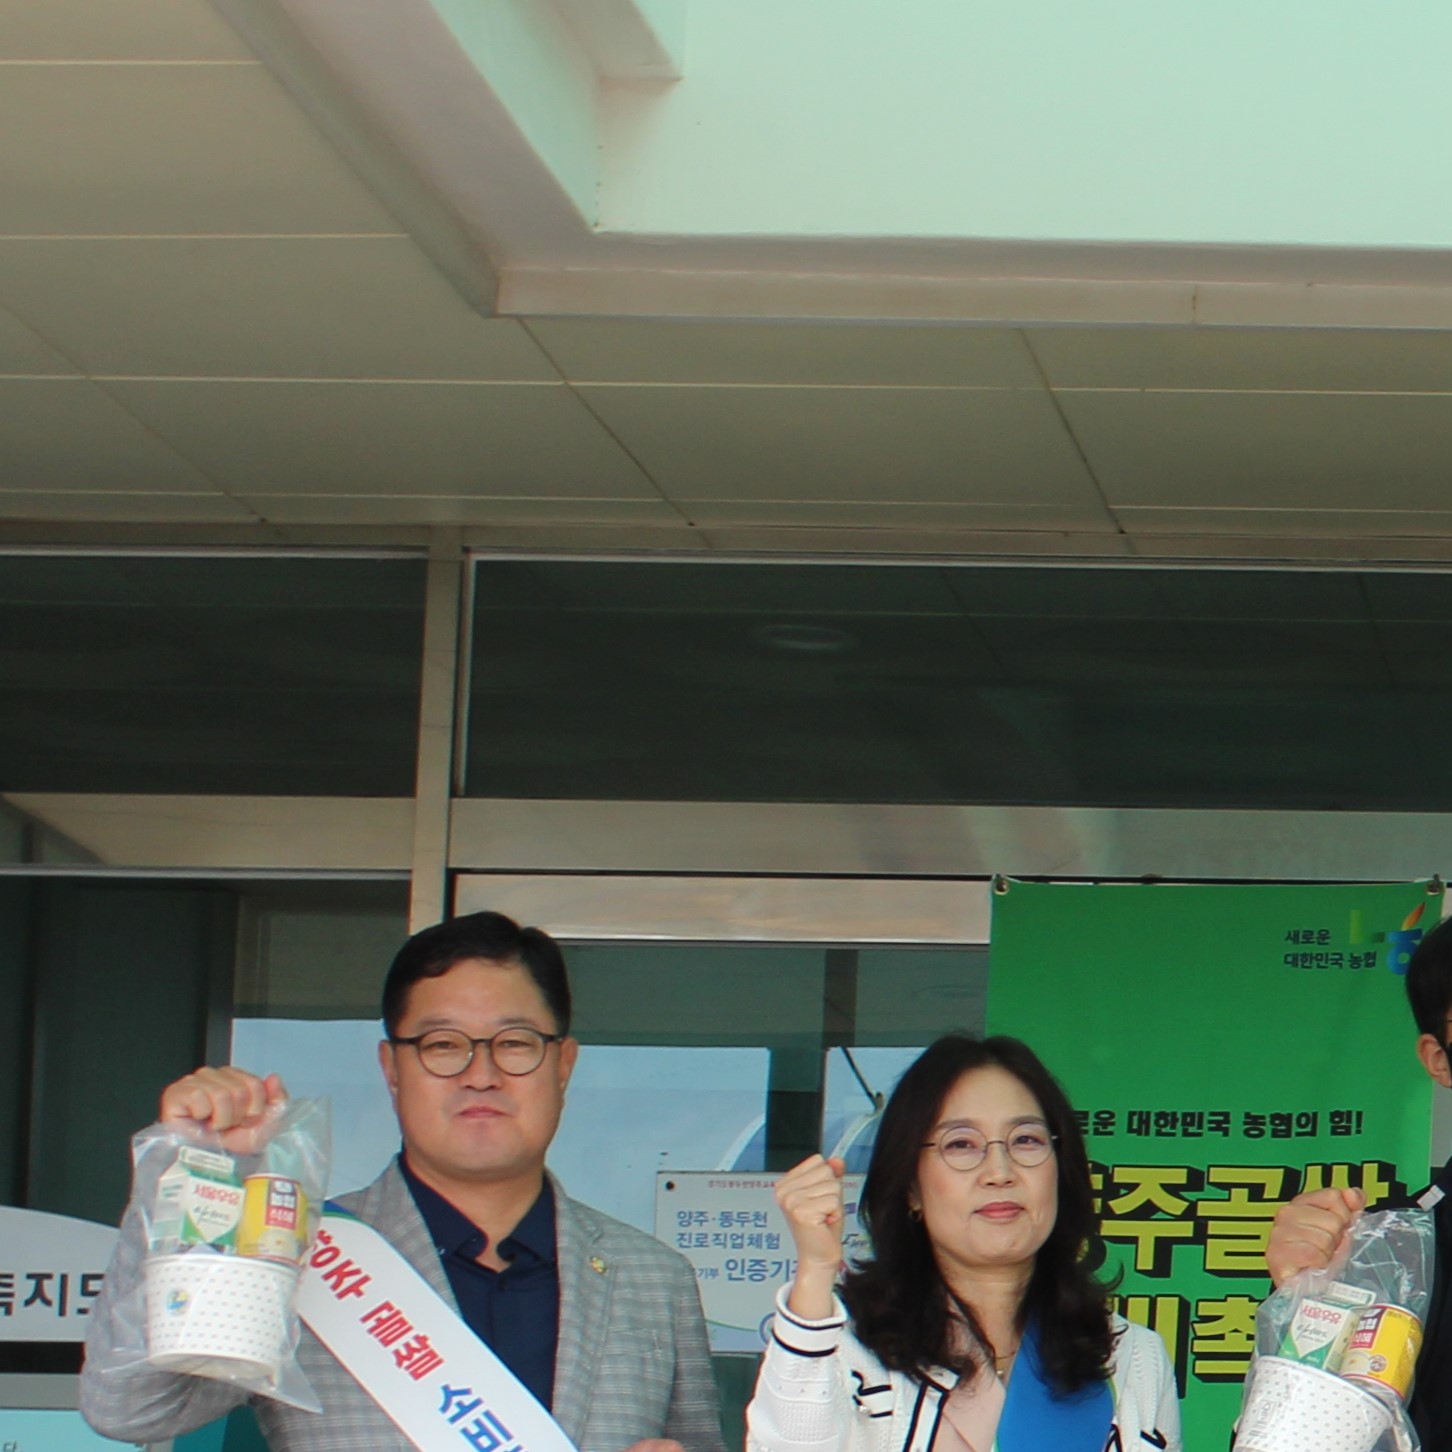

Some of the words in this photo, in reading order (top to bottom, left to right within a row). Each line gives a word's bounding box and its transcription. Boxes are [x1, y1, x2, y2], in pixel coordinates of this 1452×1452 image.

[1285, 929, 1331, 945] 새로운
[1284, 952, 1344, 969] 대한민국
[1348, 951, 1377, 969] 농협
[1127, 1110, 1232, 1138] 대한민국
[1243, 1110, 1319, 1139] 농협의
[1329, 1109, 1364, 1137] 힘!
[677, 1210, 768, 1229] 양주·동두천
[695, 1268, 719, 1280] 기부
[1301, 1305, 1342, 1326] 서울우유
[359, 1300, 445, 1382] 골쌀
